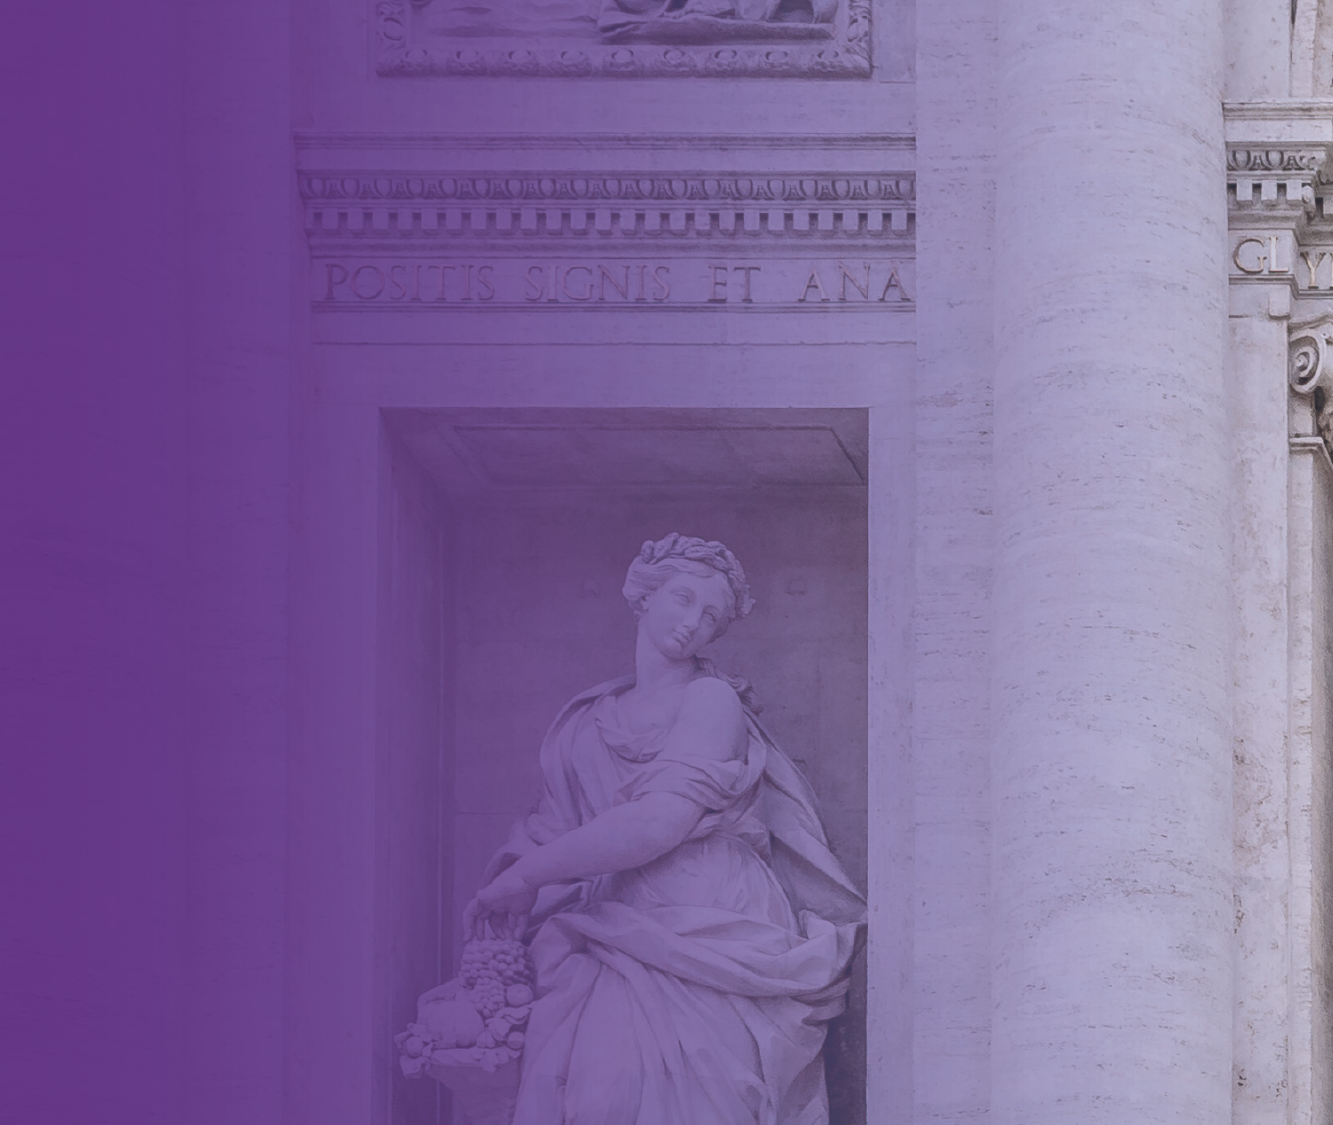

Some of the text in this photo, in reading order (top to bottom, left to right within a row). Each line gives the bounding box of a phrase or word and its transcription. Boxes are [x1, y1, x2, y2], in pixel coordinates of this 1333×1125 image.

[324, 260, 912, 303] POSITIS SIGNIS ET ANA
